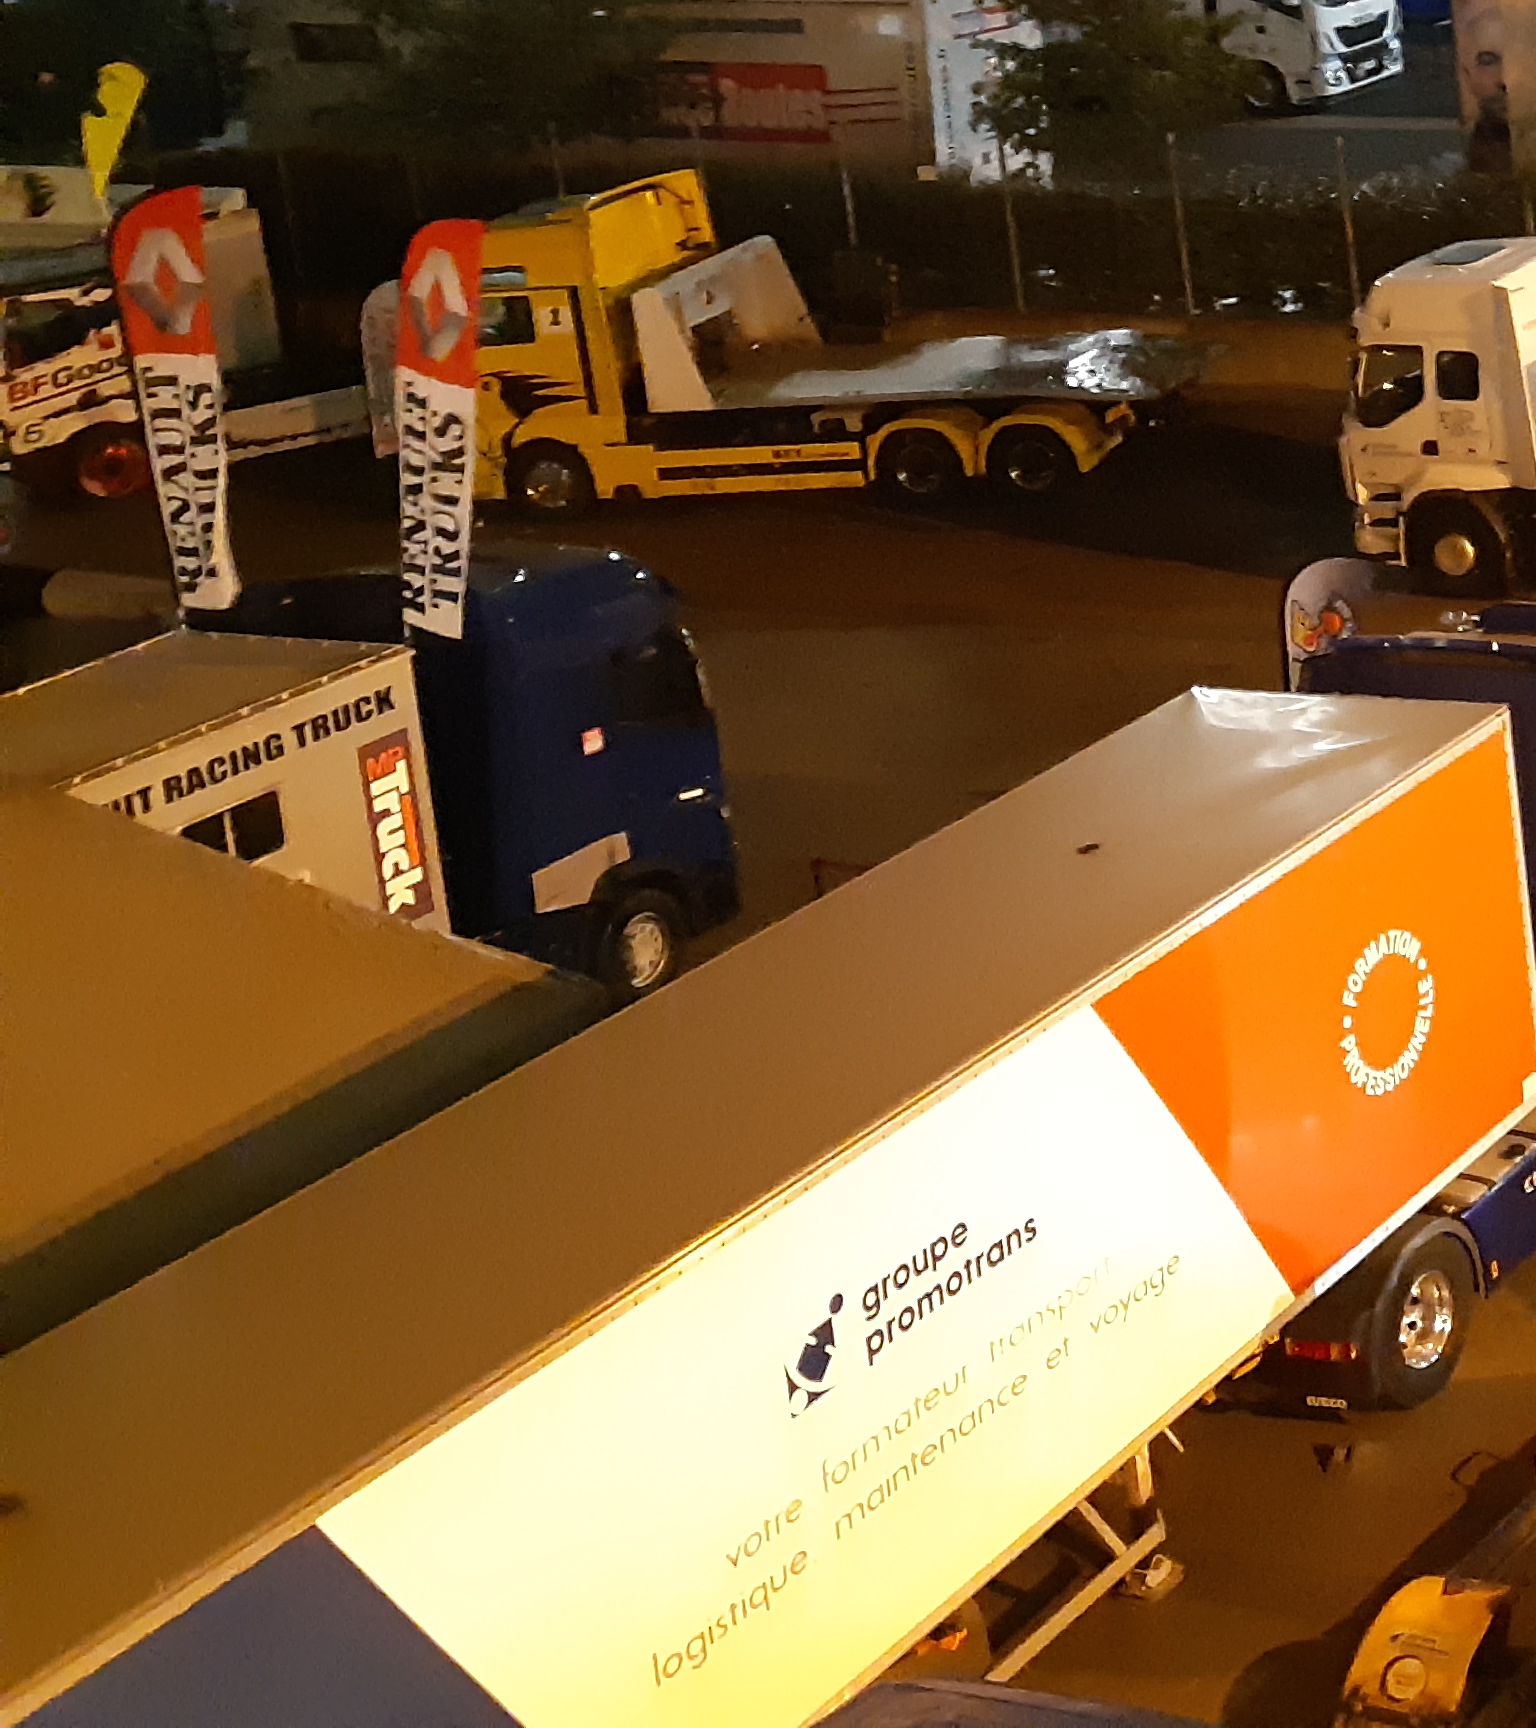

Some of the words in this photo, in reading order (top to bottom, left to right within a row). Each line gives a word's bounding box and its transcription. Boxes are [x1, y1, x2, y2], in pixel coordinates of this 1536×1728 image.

[139, 365, 204, 595] RENAULT
[400, 378, 430, 616] RENAULT
[430, 409, 467, 612] TRUCKS
[161, 732, 286, 805] RACING
[290, 684, 397, 750] TRUCK
[368, 758, 424, 915] Truck
[1339, 973, 1434, 1097] PROFESSIONNELLE
[1341, 929, 1422, 1008] FORMATION
[861, 1221, 968, 1323] groupe
[864, 1217, 1038, 1367] promotrans
[725, 1497, 804, 1569] votre
[821, 1363, 970, 1493] formateur
[834, 1373, 1029, 1540] maintenance
[1045, 1336, 1070, 1370] et
[1089, 1254, 1181, 1334] voyage
